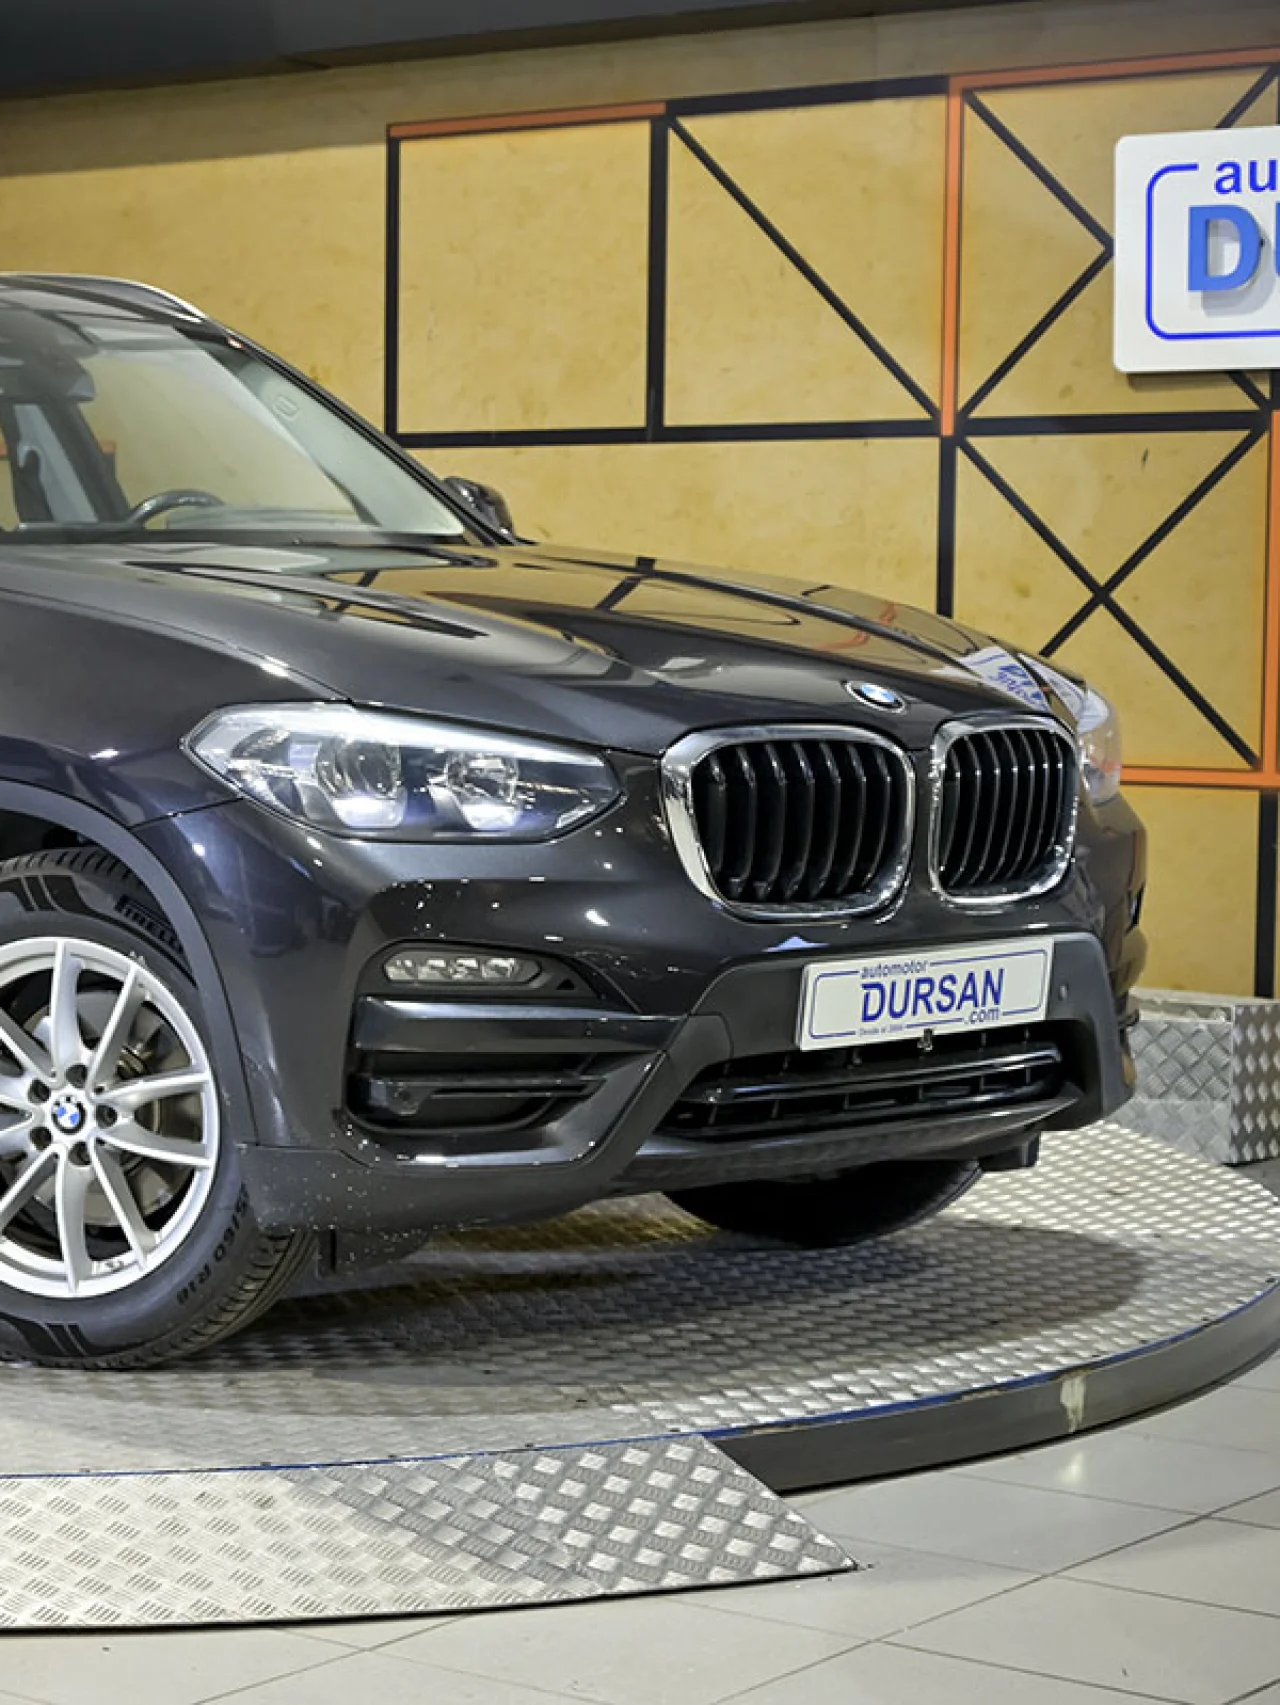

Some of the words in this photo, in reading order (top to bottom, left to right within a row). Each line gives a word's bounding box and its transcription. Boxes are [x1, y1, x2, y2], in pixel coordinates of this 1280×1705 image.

[1188, 200, 1280, 292] D
[861, 960, 928, 979] automotor
[861, 968, 1004, 1022] DURSAN
[964, 1006, 1000, 1025] .com
